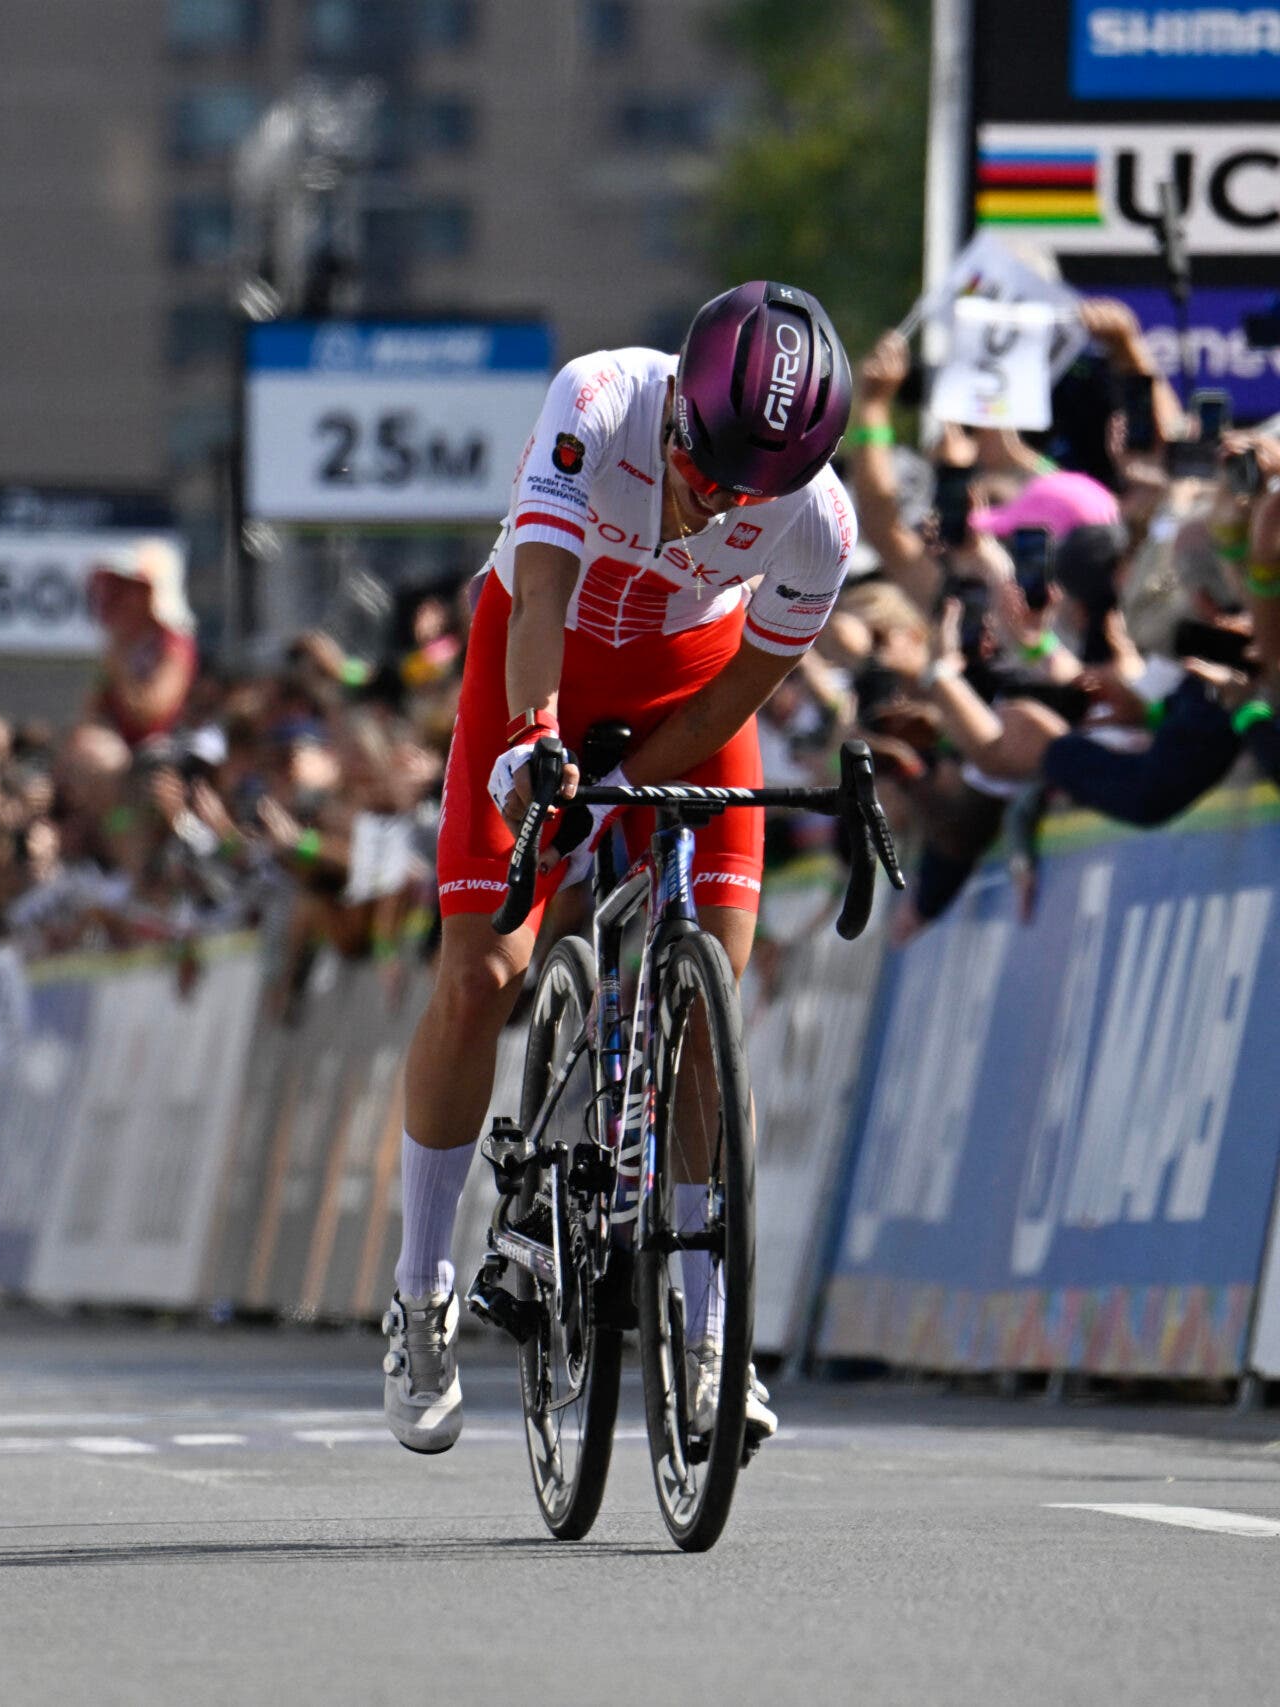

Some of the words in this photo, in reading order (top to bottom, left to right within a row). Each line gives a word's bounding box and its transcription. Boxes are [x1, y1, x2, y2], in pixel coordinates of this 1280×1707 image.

[764, 324, 801, 431] GIRO
[315, 408, 487, 488] 25M
[678, 395, 693, 450] GIRO
[527, 475, 559, 488] POLISH
[733, 484, 763, 496] GIRO
[828, 487, 851, 567] POLSKA
[510, 801, 541, 868] SRAM
